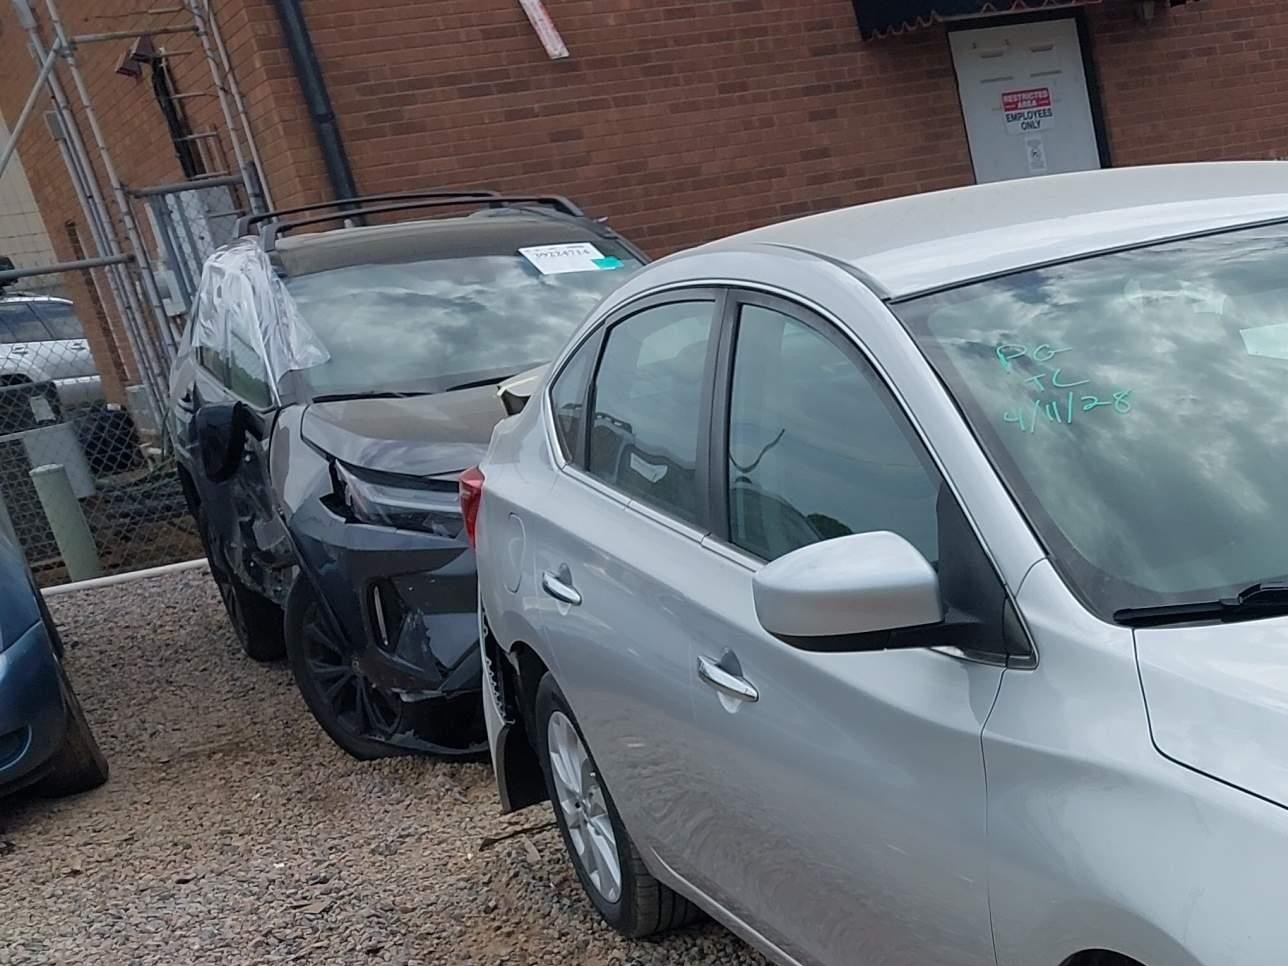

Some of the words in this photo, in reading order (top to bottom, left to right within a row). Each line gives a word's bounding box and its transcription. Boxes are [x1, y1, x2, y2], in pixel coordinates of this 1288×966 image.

[1003, 91, 1048, 103] RESTRICTED
[1017, 100, 1037, 108] AREA
[1006, 108, 1052, 122] EMPLOYEES
[1021, 120, 1041, 130] ONLY
